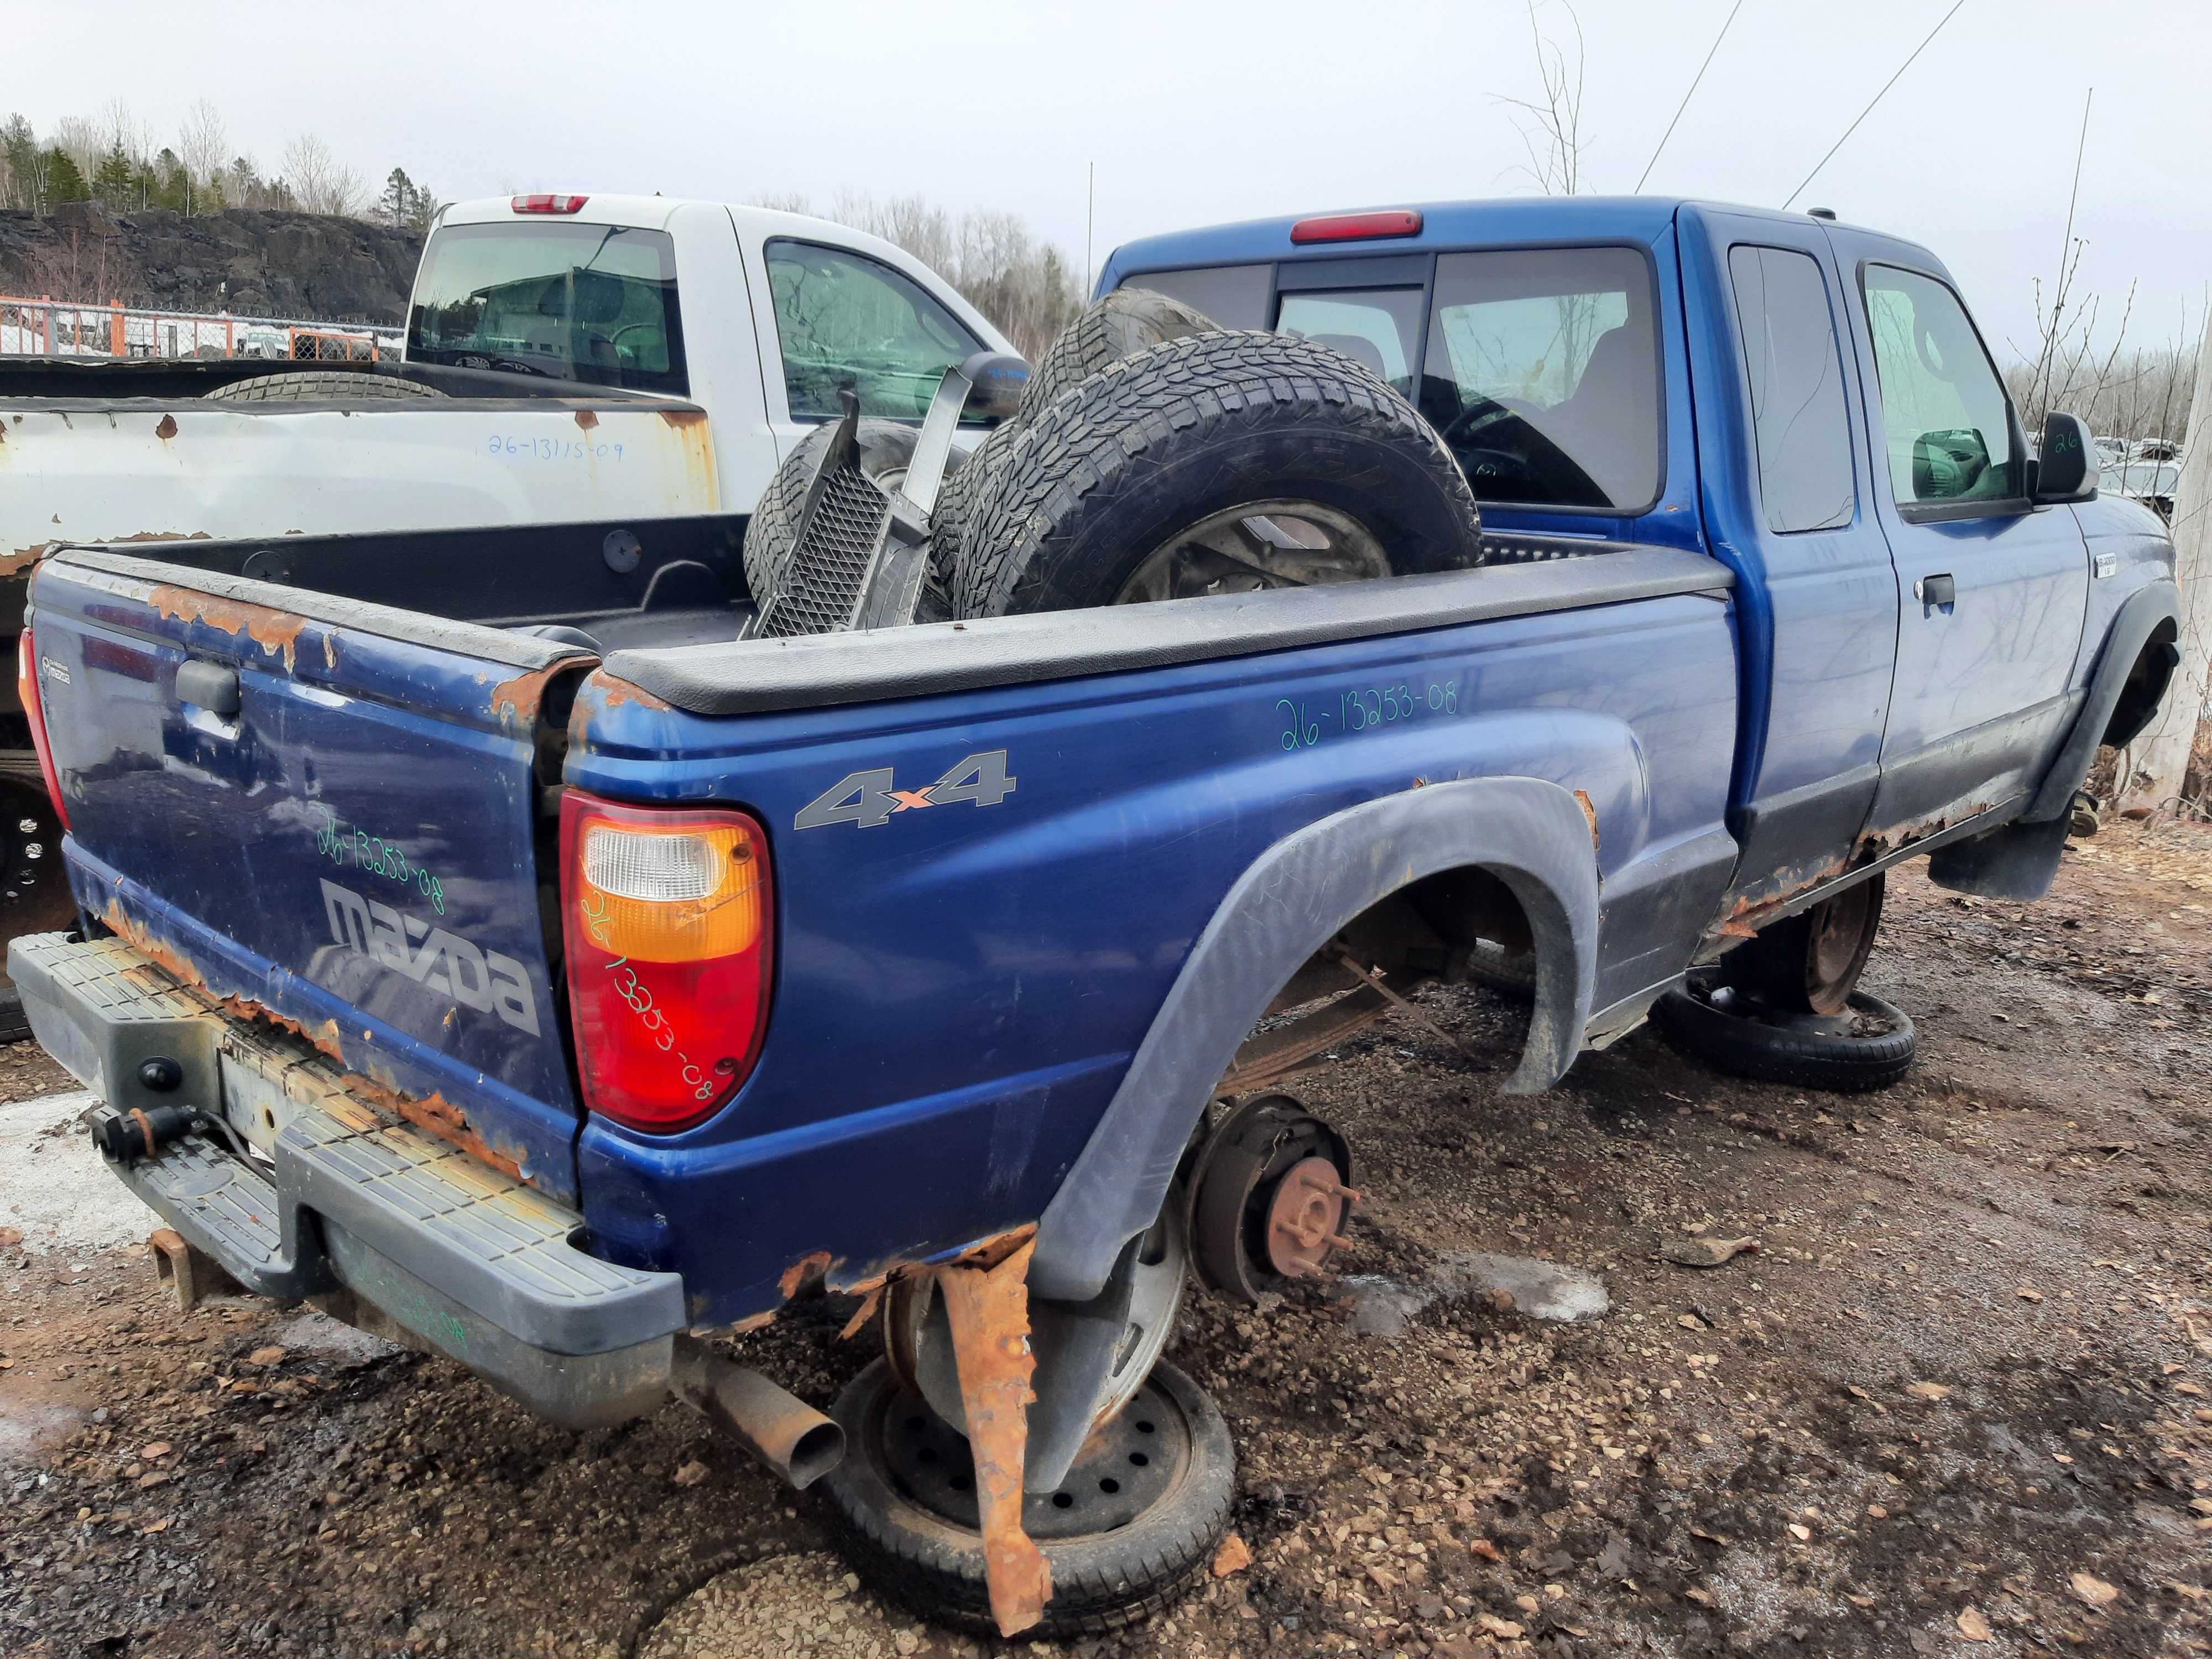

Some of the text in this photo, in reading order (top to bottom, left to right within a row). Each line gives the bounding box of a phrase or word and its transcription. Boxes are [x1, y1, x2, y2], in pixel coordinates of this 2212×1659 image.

[488, 435, 623, 463] 26-13115-09
[2054, 431, 2078, 453] 26
[1276, 681, 1457, 750] 26-13253-08
[317, 806, 445, 916] 26-13253-08
